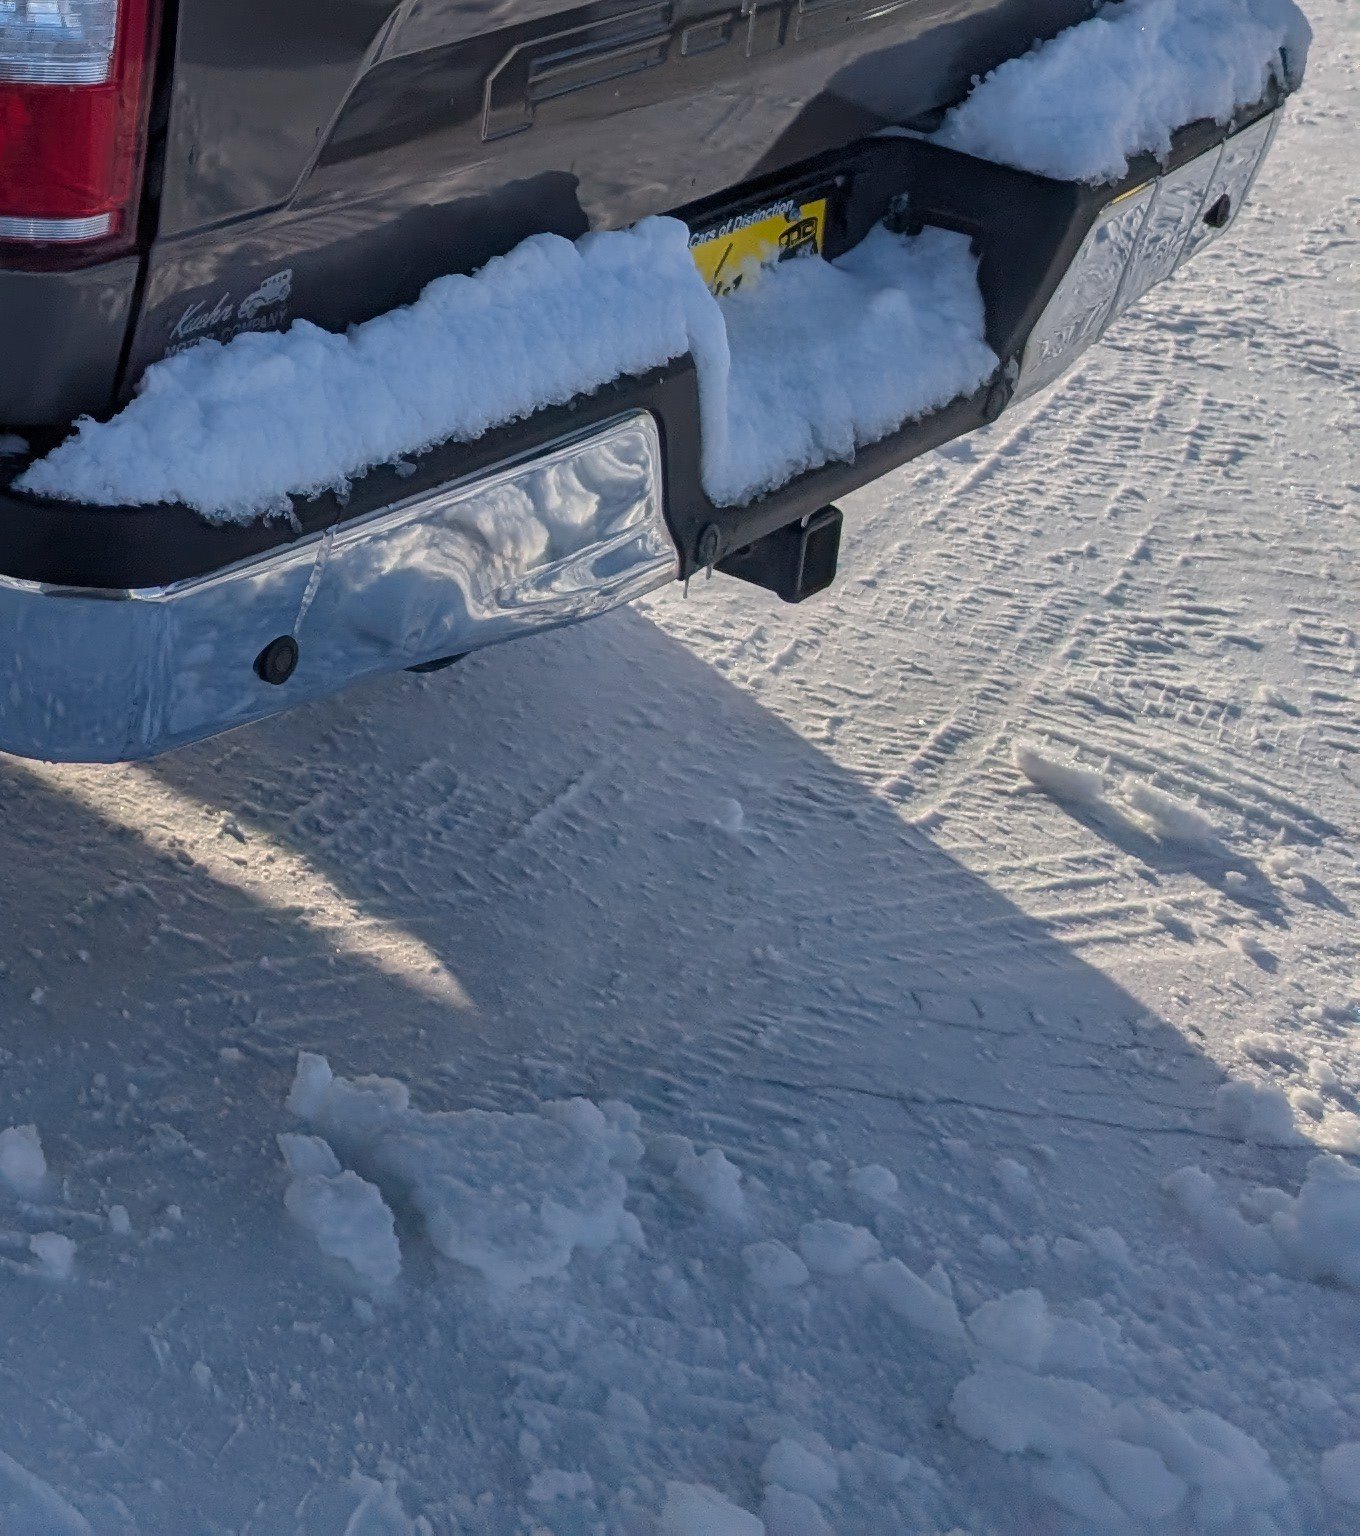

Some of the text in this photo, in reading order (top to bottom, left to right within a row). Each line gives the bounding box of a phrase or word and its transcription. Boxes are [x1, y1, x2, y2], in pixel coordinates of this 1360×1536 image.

[689, 199, 795, 249] Cars of Distinction
